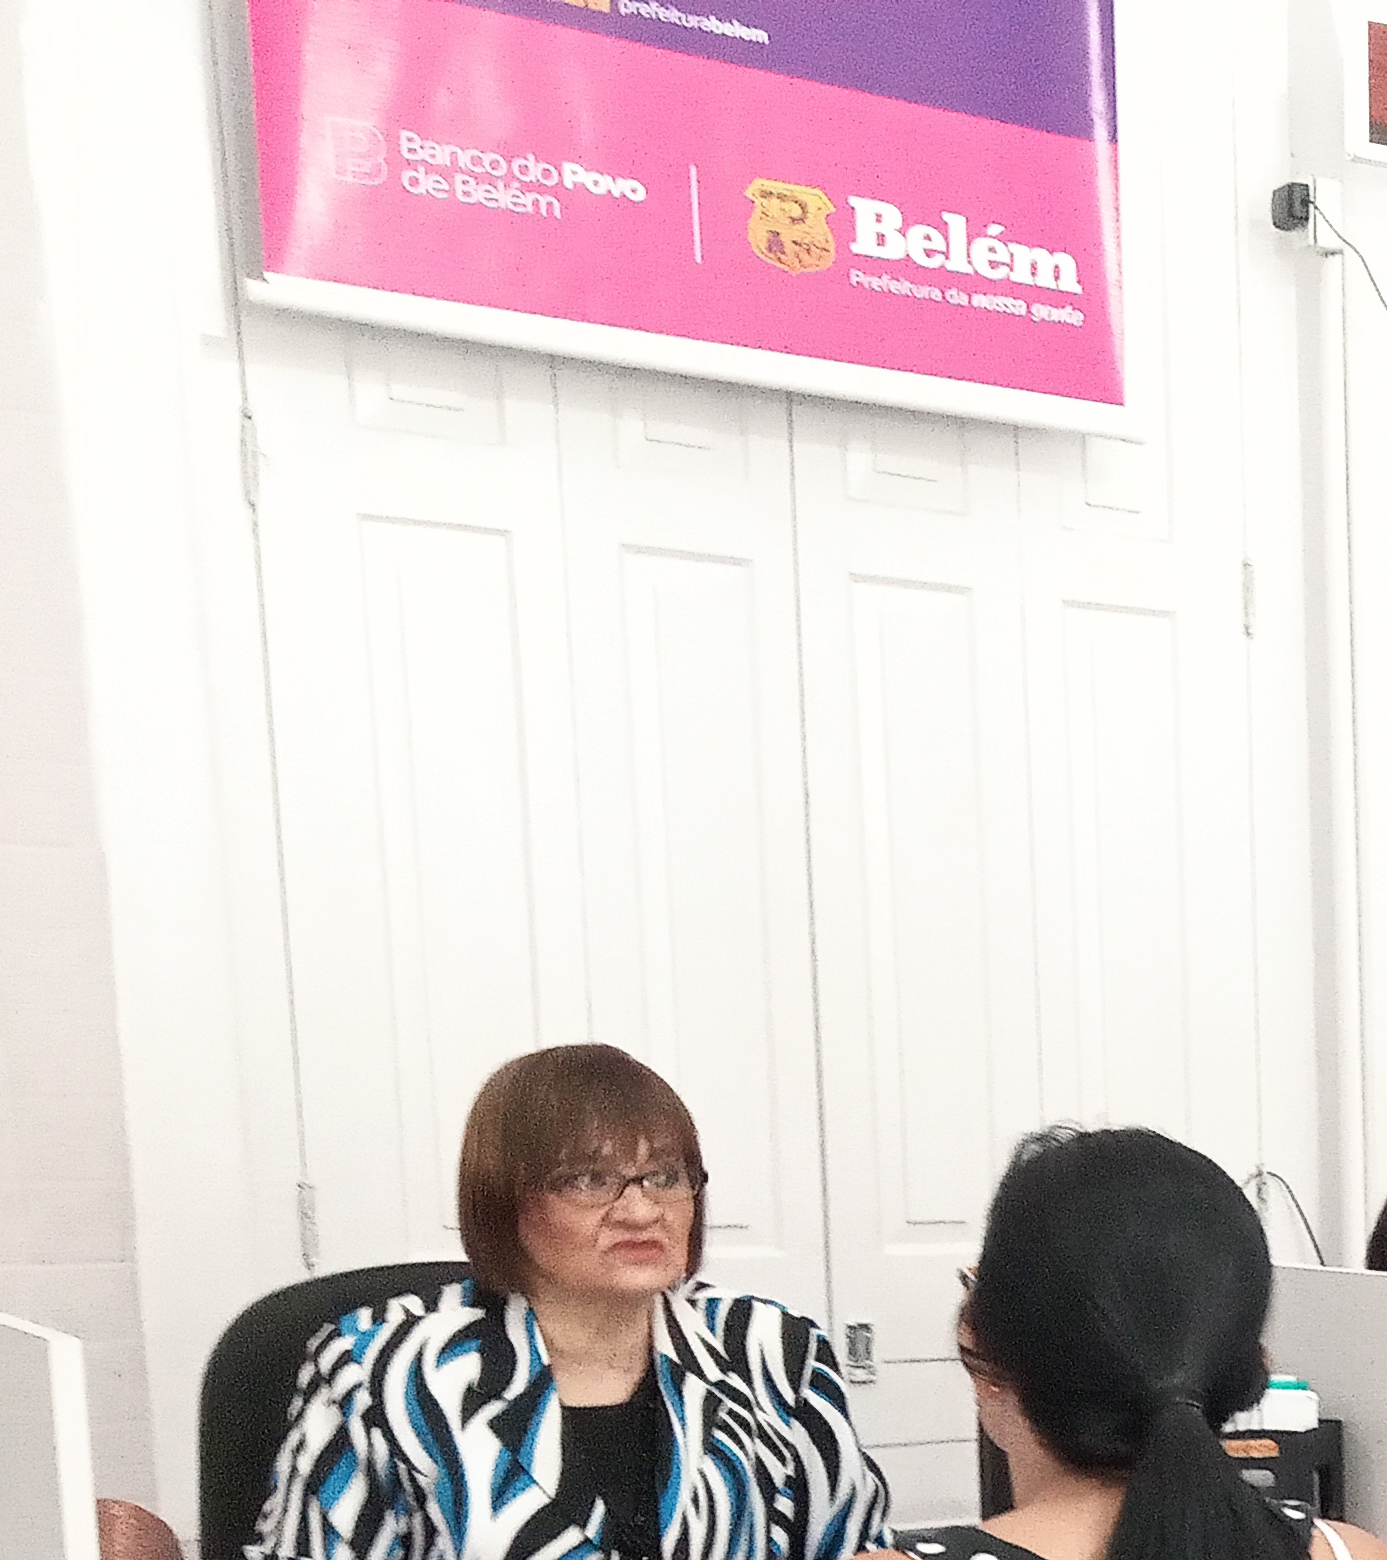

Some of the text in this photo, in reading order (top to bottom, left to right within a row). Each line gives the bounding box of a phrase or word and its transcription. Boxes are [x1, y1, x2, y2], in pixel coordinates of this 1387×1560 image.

[398, 128, 647, 203] Banco do Povo
[401, 164, 562, 220] de Belém
[847, 195, 1083, 296] Belém
[849, 267, 943, 303] Prefeitura
[944, 287, 970, 307] da
